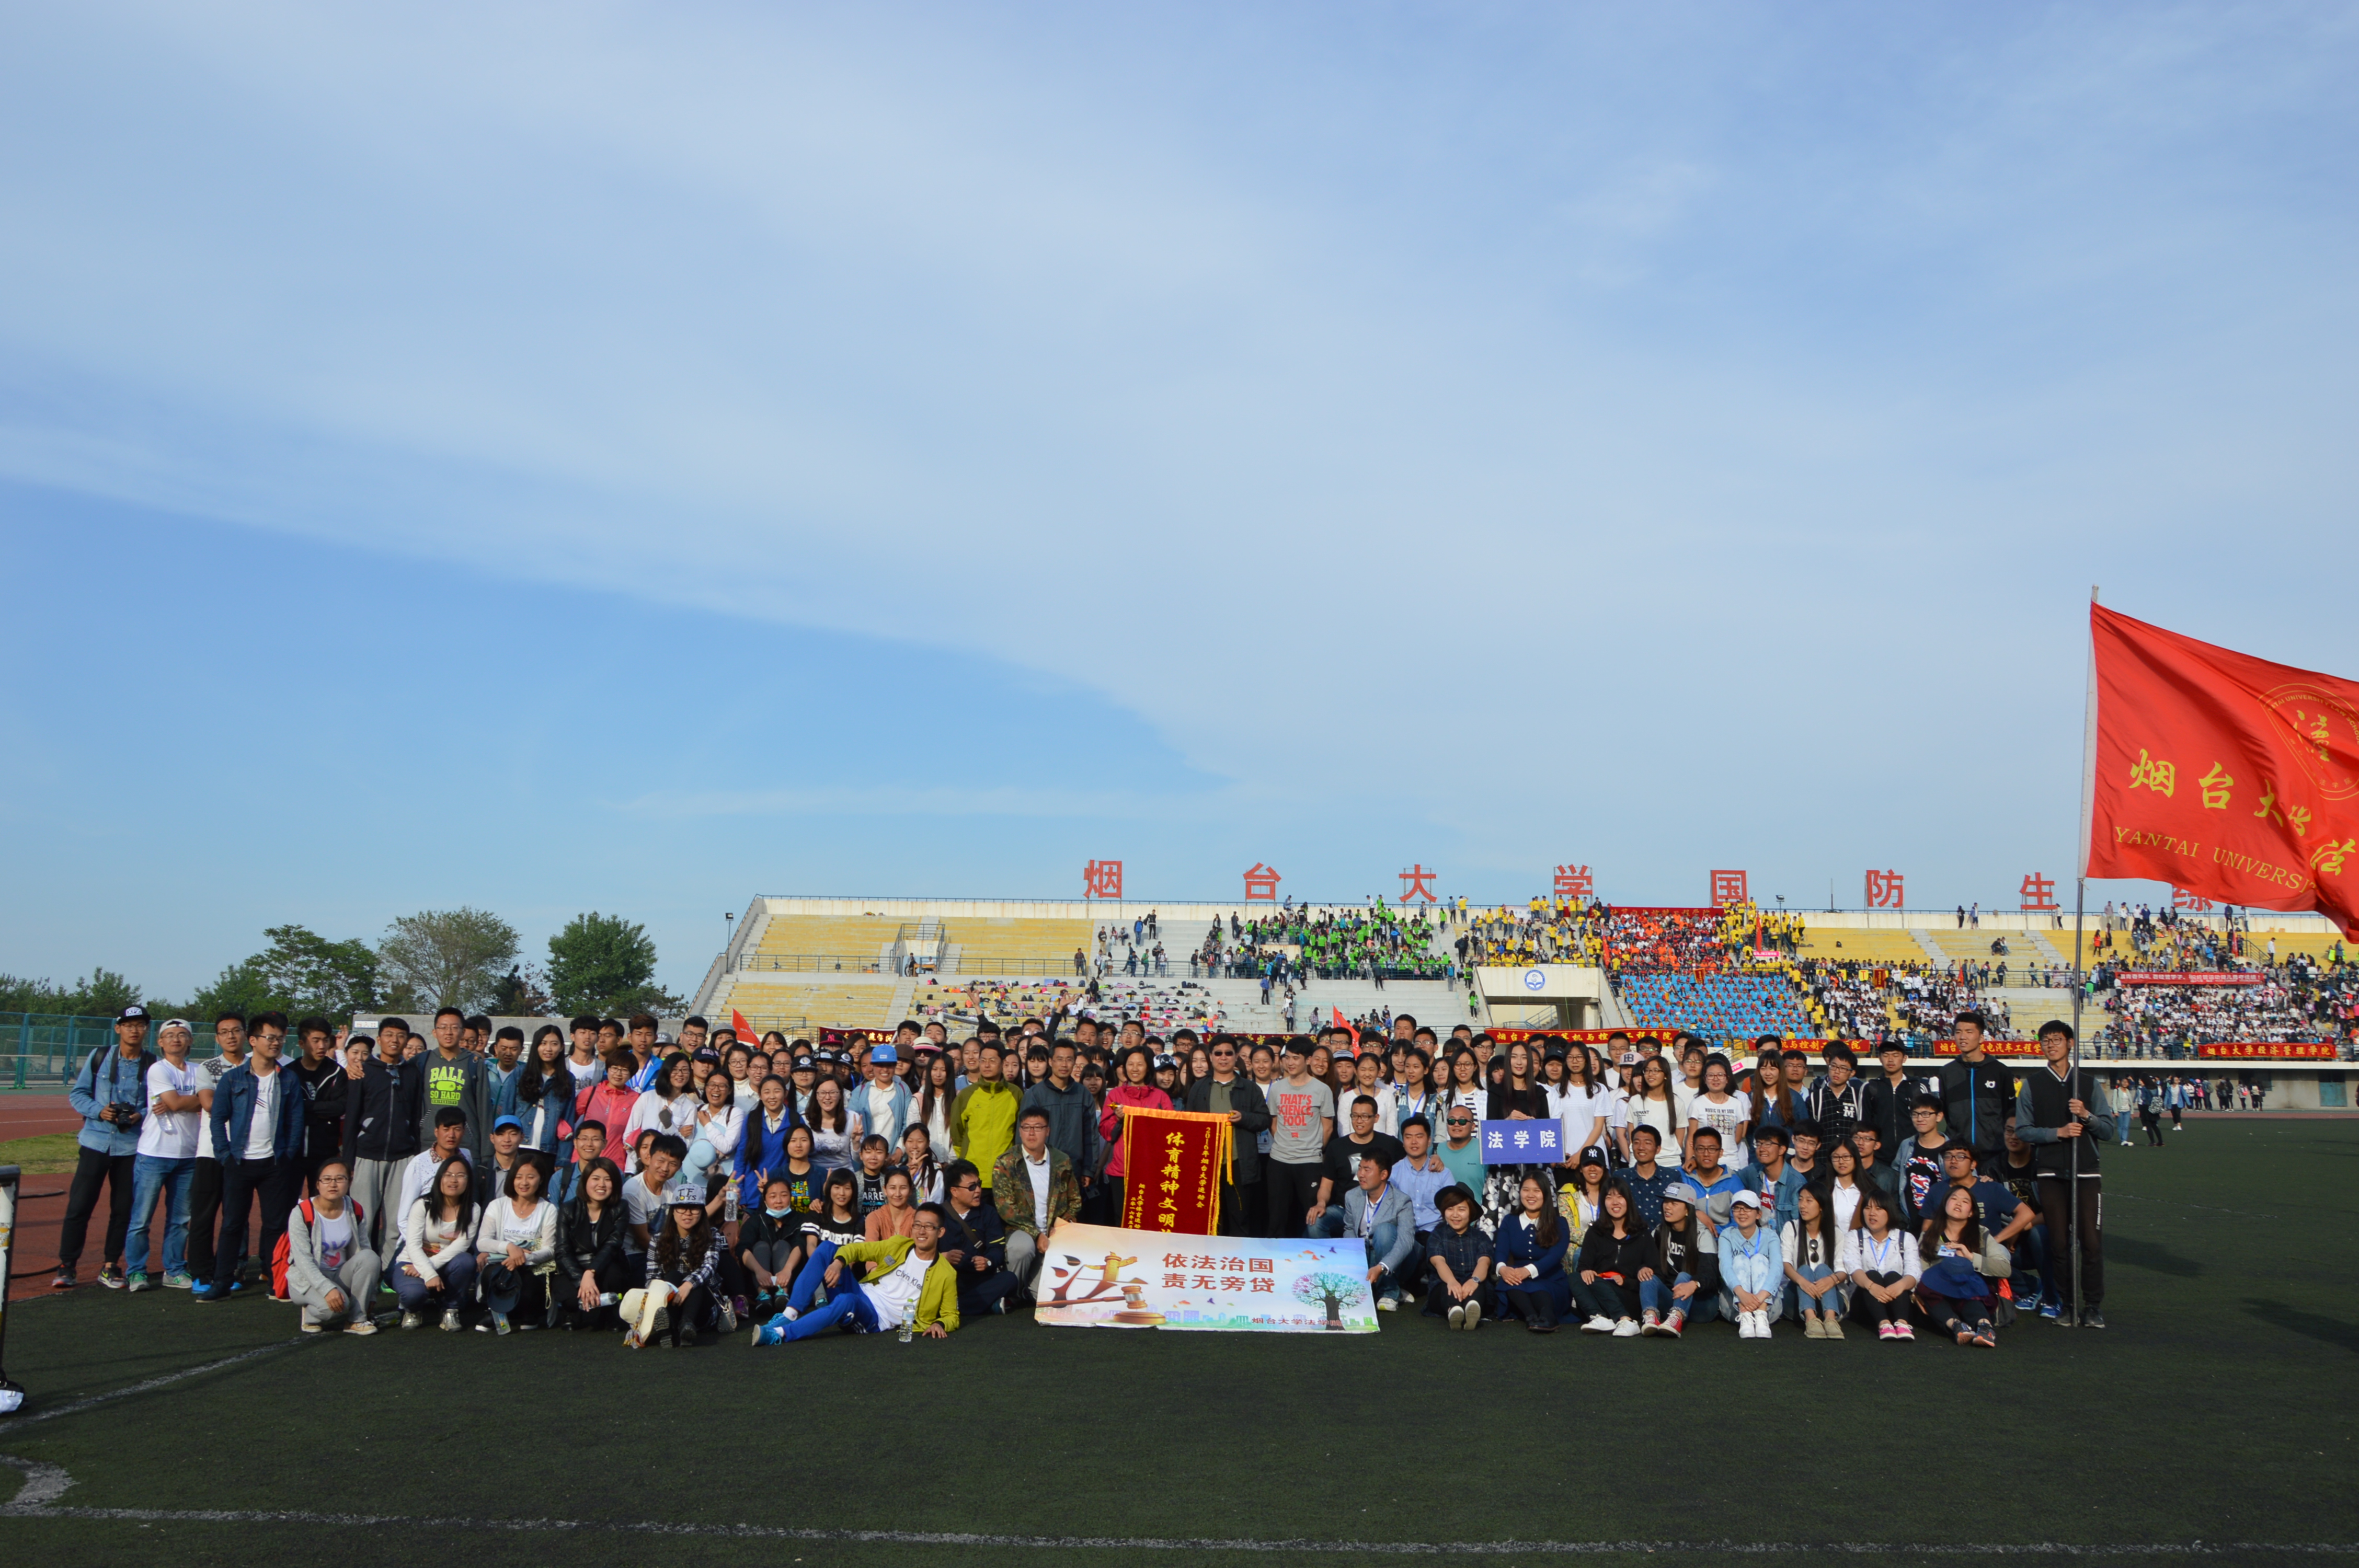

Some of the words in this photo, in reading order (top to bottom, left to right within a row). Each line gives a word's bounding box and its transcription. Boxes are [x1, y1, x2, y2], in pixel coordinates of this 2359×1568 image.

[2285, 694, 2329, 707] UNIVERSITY
[2115, 827, 2199, 857] YANTAI
[1940, 1042, 2041, 1053] 烟台机电汽车工程学
[2206, 1045, 2331, 1055] 烟台大学经济管理学院
[429, 1066, 465, 1085] BALL
[430, 1090, 439, 1099] SO
[441, 1091, 461, 1101] HARD
[1280, 1094, 1312, 1105] THAT'S
[1283, 1115, 1307, 1126] FOOL
[1487, 1130, 1556, 1149] 法学院
[1588, 1148, 1598, 1158] NY
[1196, 1127, 1211, 1208] 2016年烟台大学运动会
[1158, 1132, 1185, 1232] 体育精神文明
[1162, 1253, 1274, 1274] 依法治国
[1161, 1273, 1275, 1294] 责无旁贷
[1252, 1317, 1342, 1327] 烟台大学法学院
